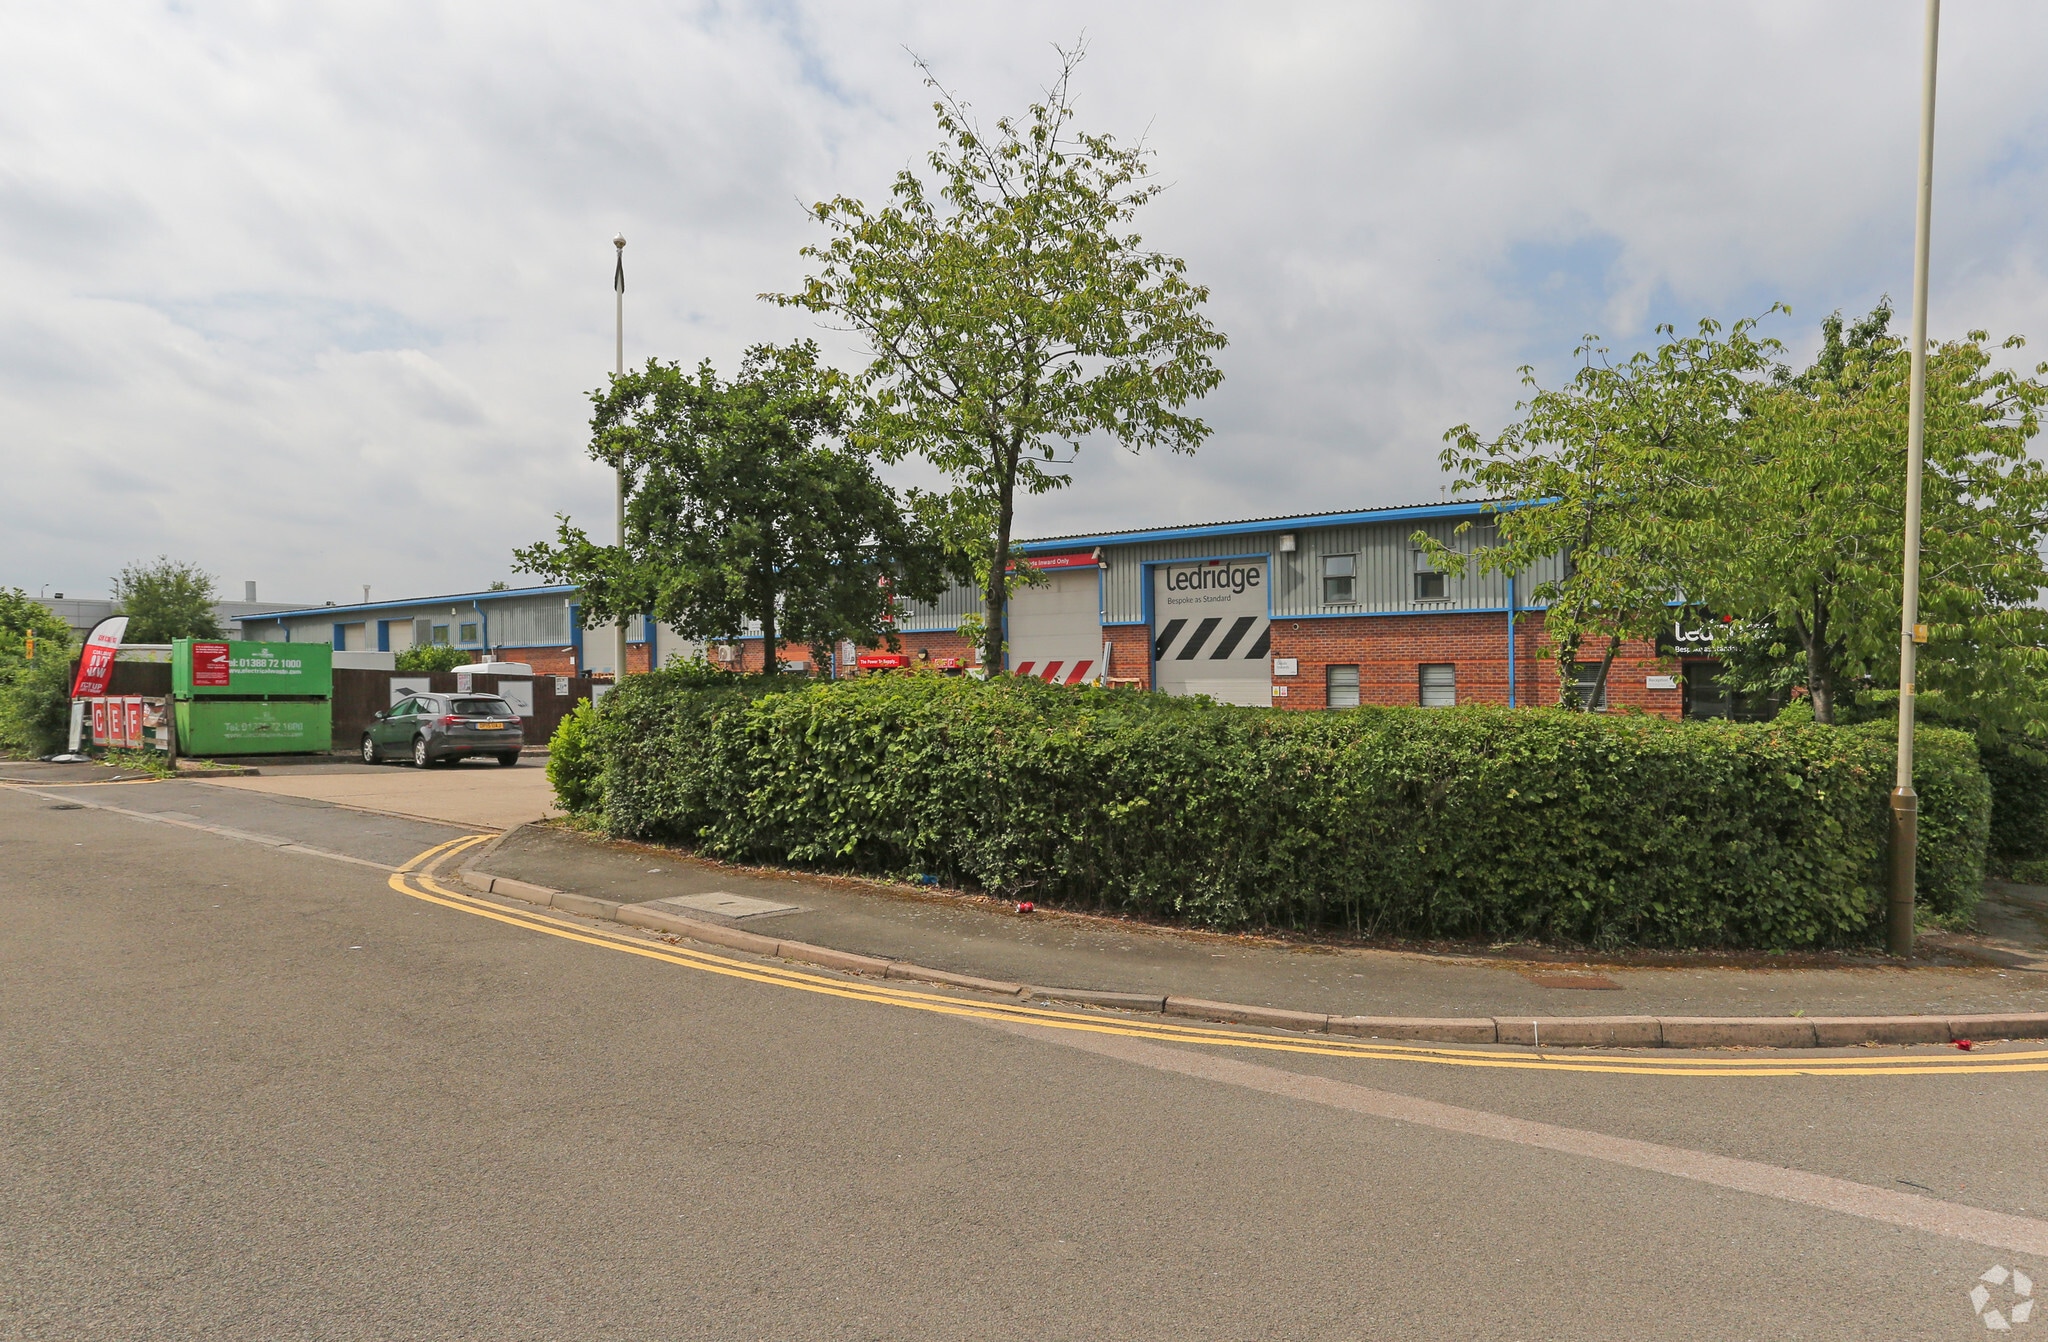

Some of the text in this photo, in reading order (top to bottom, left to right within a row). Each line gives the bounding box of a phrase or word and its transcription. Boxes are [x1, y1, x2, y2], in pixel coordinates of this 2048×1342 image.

[1167, 596, 1193, 605] Bespoke
[1203, 595, 1231, 603] Standard
[239, 658, 267, 667] 01388
[268, 659, 279, 668] 72
[281, 659, 302, 668] 1000
